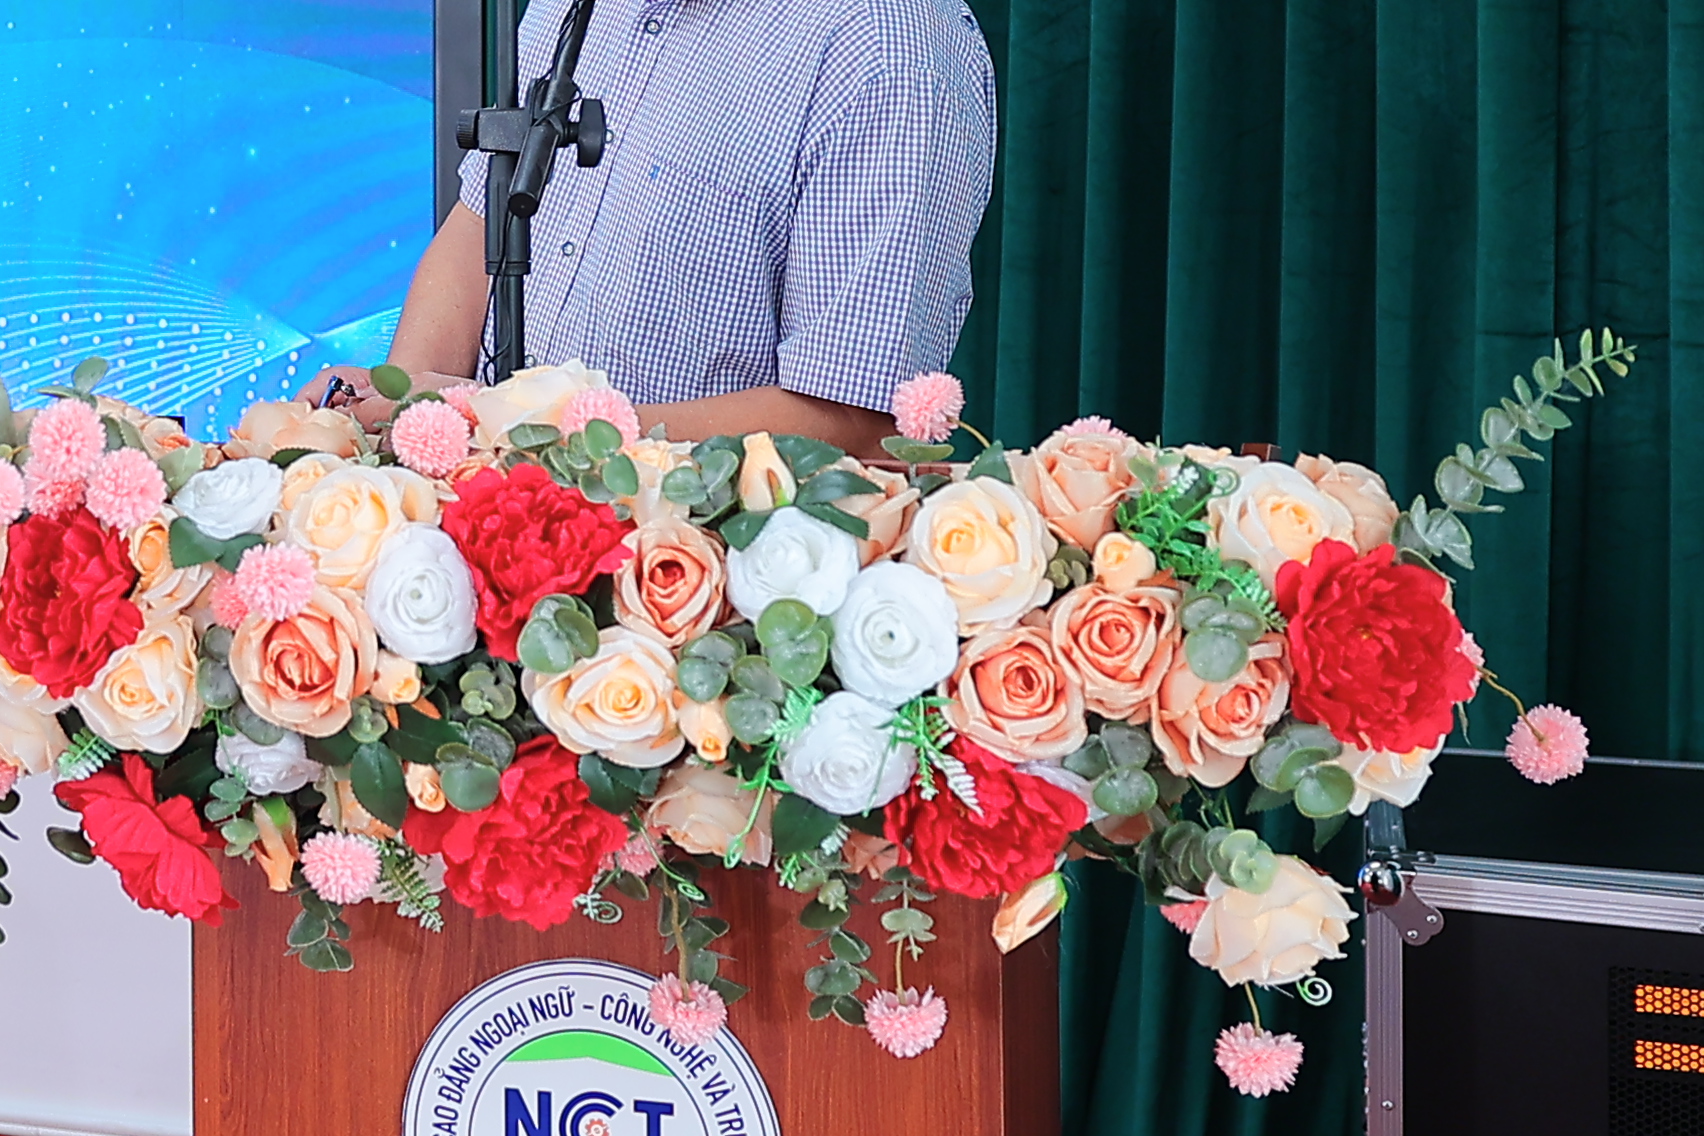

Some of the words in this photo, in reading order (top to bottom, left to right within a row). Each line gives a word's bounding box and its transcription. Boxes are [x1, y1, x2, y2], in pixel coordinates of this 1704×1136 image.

[527, 985, 575, 1023] NGỮ
[468, 1002, 531, 1057] NGOẠI
[434, 1046, 482, 1104] ĐẲNG
[701, 1071, 736, 1107] VÀ
[432, 1105, 459, 1136] AO
